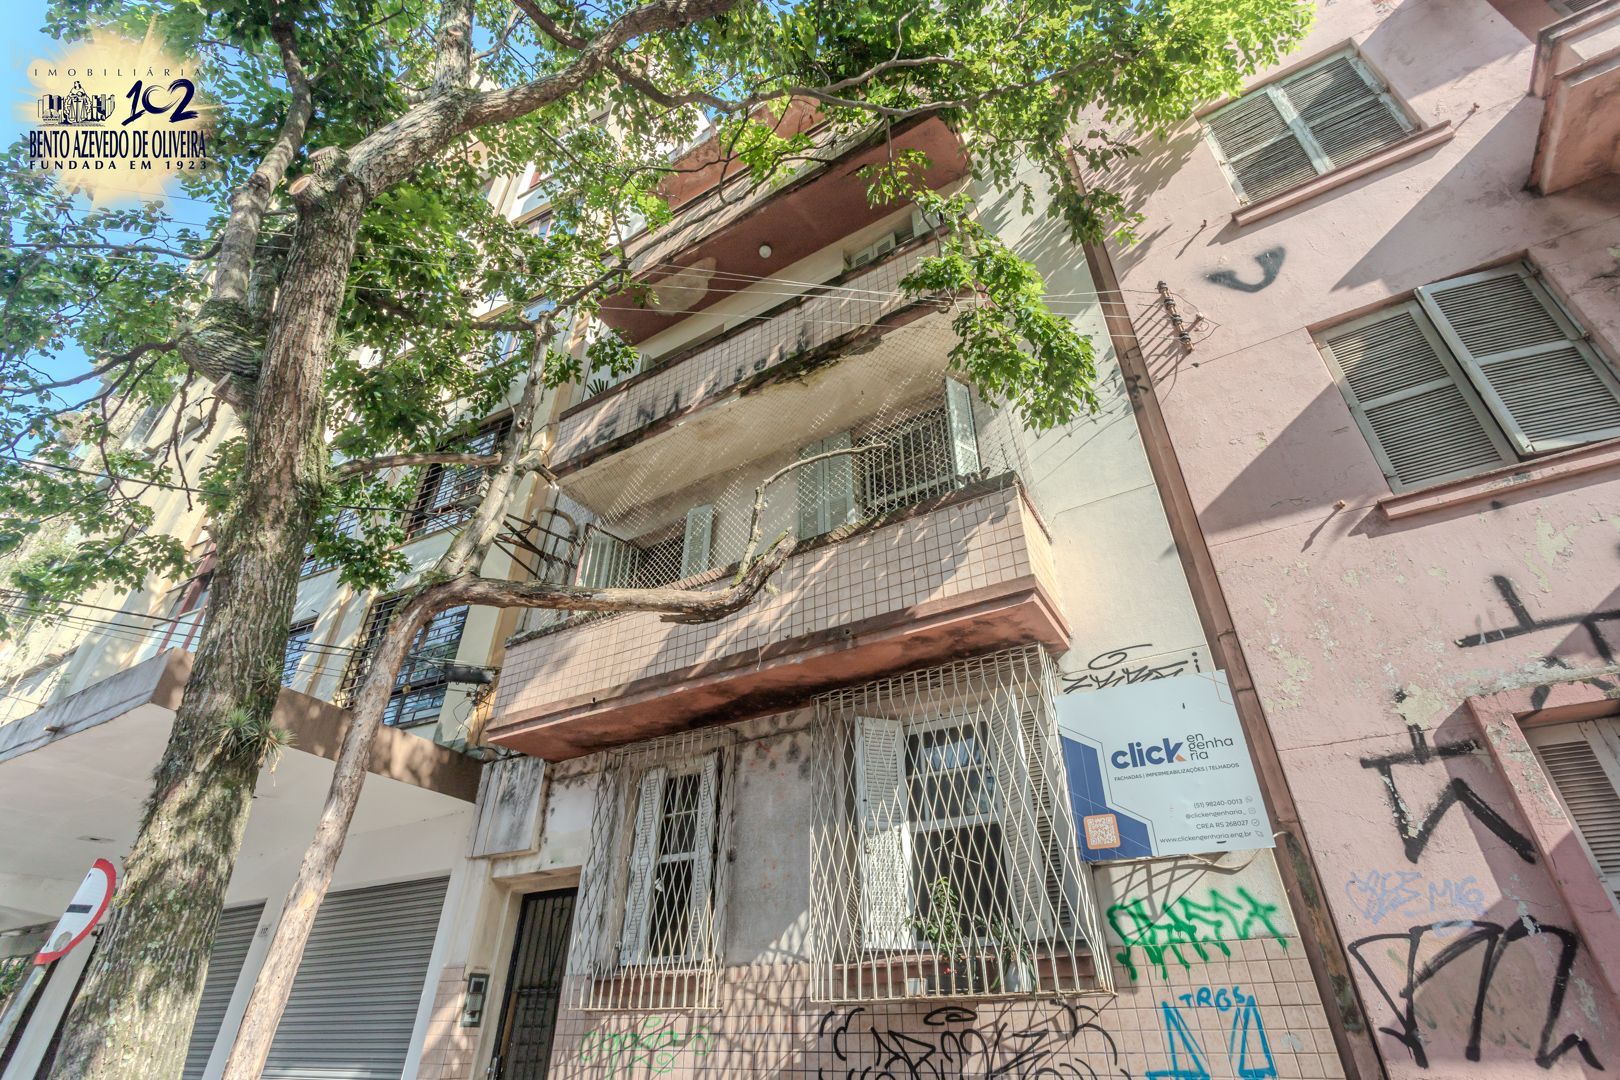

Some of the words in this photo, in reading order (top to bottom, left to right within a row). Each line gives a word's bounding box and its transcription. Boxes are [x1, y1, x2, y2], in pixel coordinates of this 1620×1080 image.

[1186, 733, 1204, 743] en
[1188, 737, 1234, 752] genha
[1111, 737, 1187, 769] click
[1190, 750, 1209, 761] ria
[1114, 773, 1142, 782] FACHADAS
[1145, 764, 1205, 778] IMPERMEABILIZAÇÕES
[1209, 762, 1240, 771] TELHADOS
[1195, 822, 1214, 830] CREA
[1225, 819, 1249, 828] 268027
